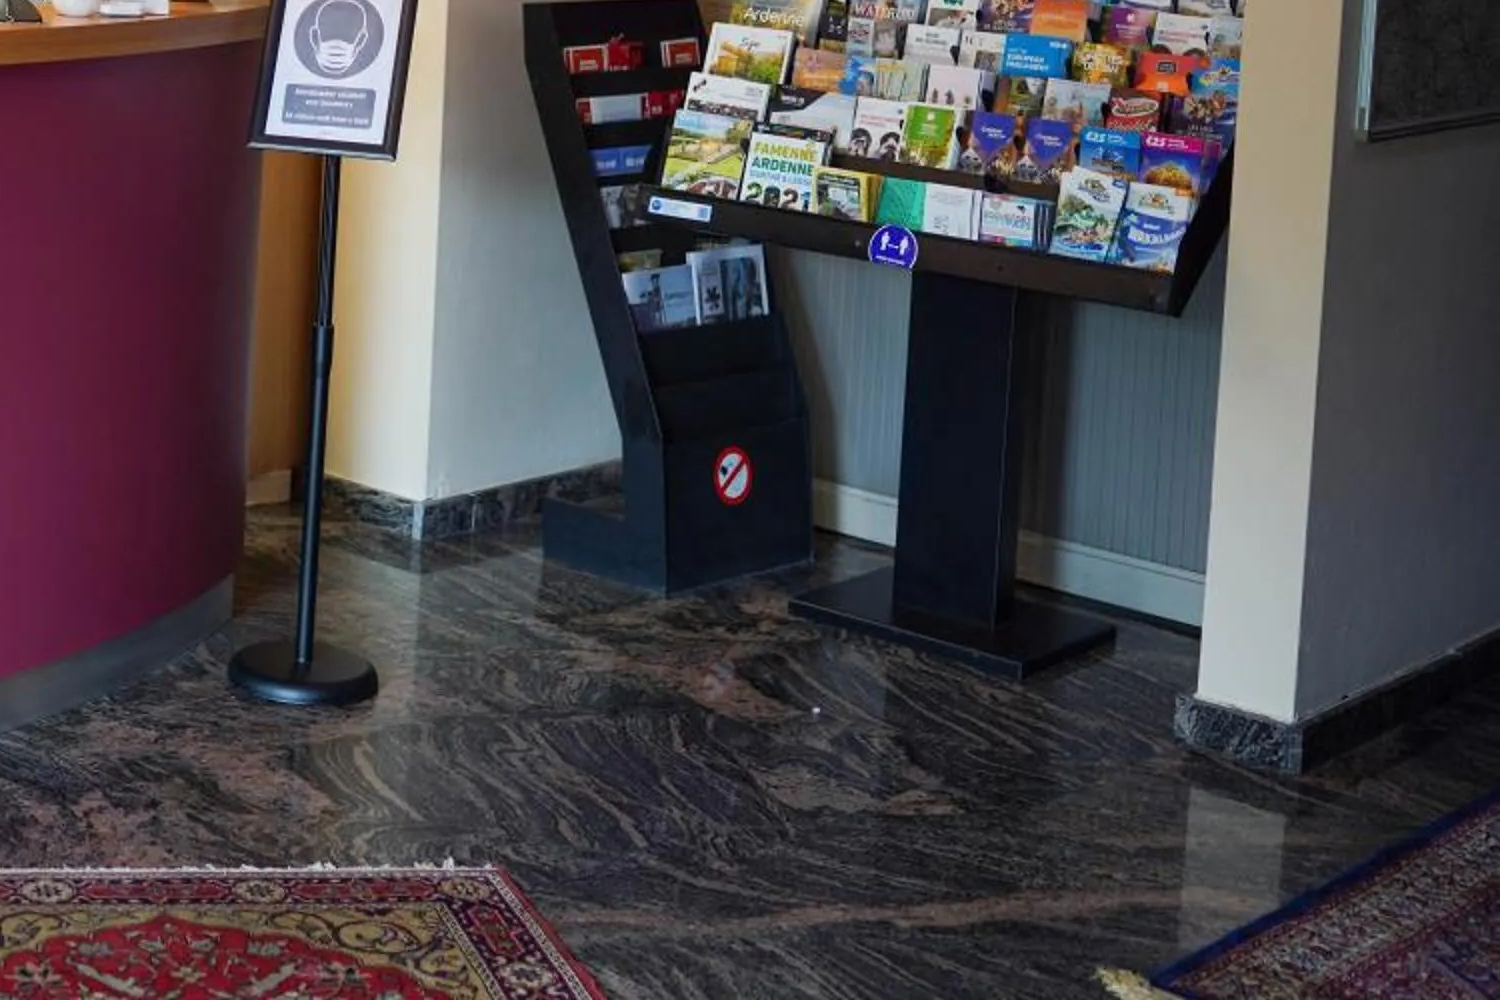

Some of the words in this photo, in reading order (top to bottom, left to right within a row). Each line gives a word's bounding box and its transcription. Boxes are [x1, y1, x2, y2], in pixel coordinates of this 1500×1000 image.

[743, 7, 804, 27] Ardenne
[752, 156, 814, 176] ARDENNE
[746, 182, 811, 210] 2021
